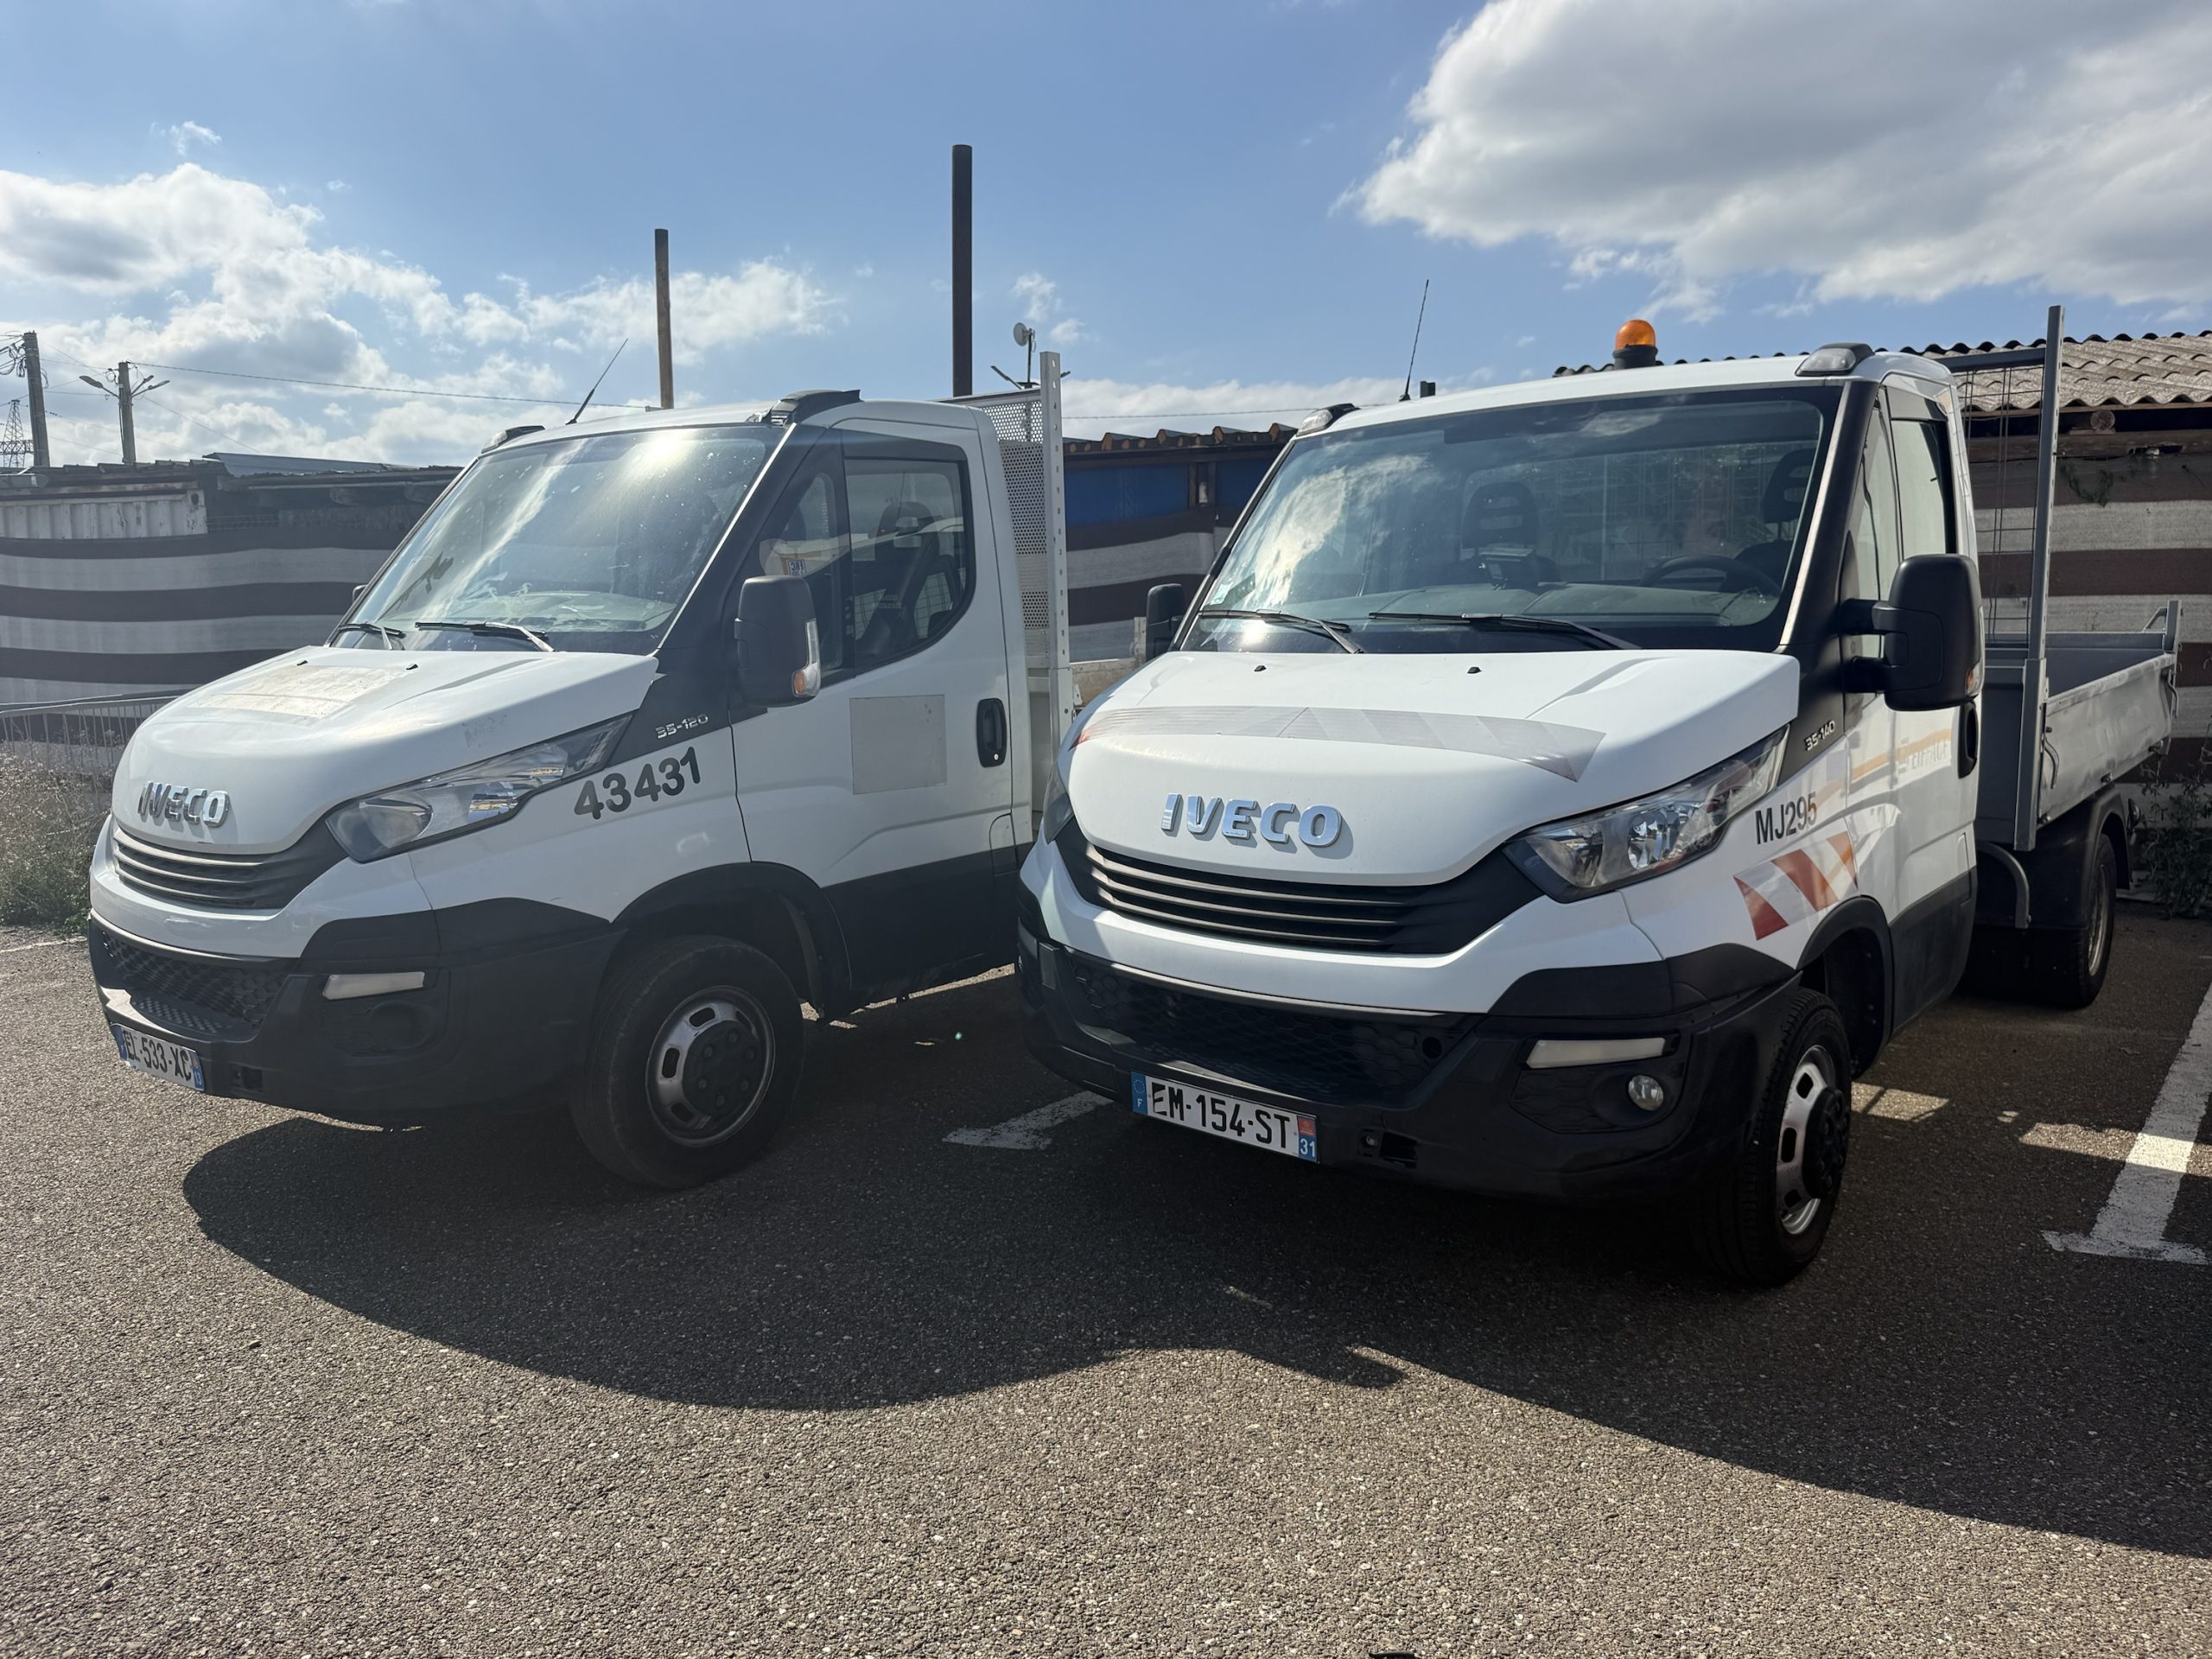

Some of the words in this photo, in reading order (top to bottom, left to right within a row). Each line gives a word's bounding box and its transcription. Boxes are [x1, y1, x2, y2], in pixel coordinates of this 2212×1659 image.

[655, 714, 709, 739] 35-120
[1805, 719, 1836, 751] 35-140
[137, 780, 230, 828] IVECO
[574, 747, 701, 820] 43431
[1160, 792, 1342, 848] IVECO
[1755, 791, 1817, 845] MJ295
[1136, 1098, 1143, 1108] F
[1152, 1082, 1291, 1149] EM-154-ST
[1300, 1138, 1315, 1158] 31
